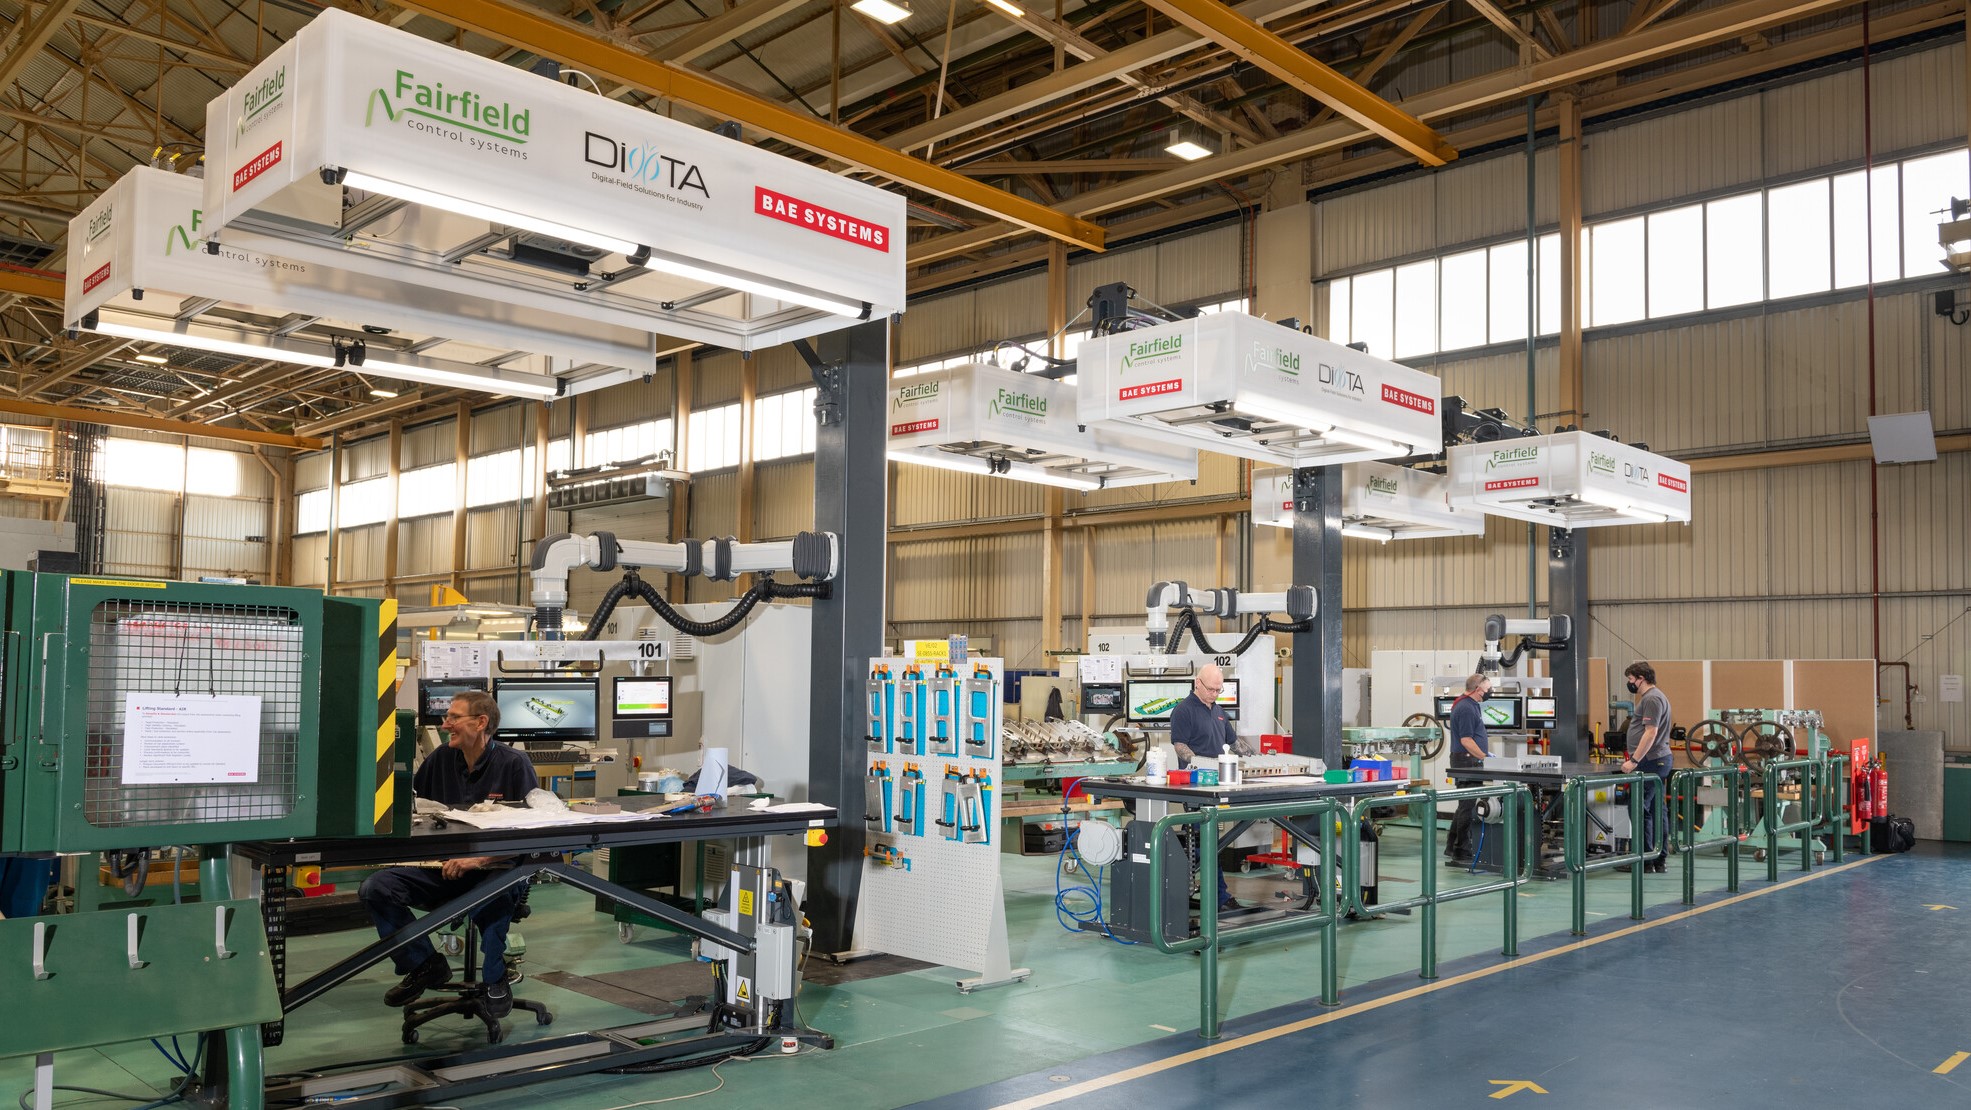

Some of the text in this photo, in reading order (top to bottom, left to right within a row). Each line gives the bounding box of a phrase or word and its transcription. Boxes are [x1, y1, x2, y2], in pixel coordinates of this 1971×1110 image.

[244, 65, 285, 115] Fairfield
[263, 101, 283, 121] systems
[396, 69, 529, 136] Fairfield
[408, 119, 528, 160] control systems
[236, 147, 280, 186] BAE SYSTEMS
[591, 172, 703, 211] Digital-Field Solutions for Industry
[90, 203, 112, 237] Fairfield
[762, 194, 883, 245] BAE SYSTEMS
[202, 246, 306, 273] cntrol systems
[1130, 334, 1182, 357] Fairfield
[1134, 354, 1181, 368] control systems
[900, 381, 939, 399] Fairfield
[1122, 381, 1179, 399] BAE SYSTEMS
[998, 388, 1047, 412] Fairfield
[1384, 388, 1432, 412] BAE SYSTEMS
[894, 421, 937, 433] BAE SYSTEMS
[1003, 411, 1046, 425] control systems
[1494, 446, 1538, 460] Fairfield
[1591, 451, 1615, 469] Fairfield
[1370, 475, 1397, 491] Fairfield
[1503, 478, 1537, 487] SYSTEMS
[607, 622, 618, 634] 101
[638, 643, 662, 657] 101
[1098, 643, 1110, 652] 102
[1214, 656, 1231, 667] 102
